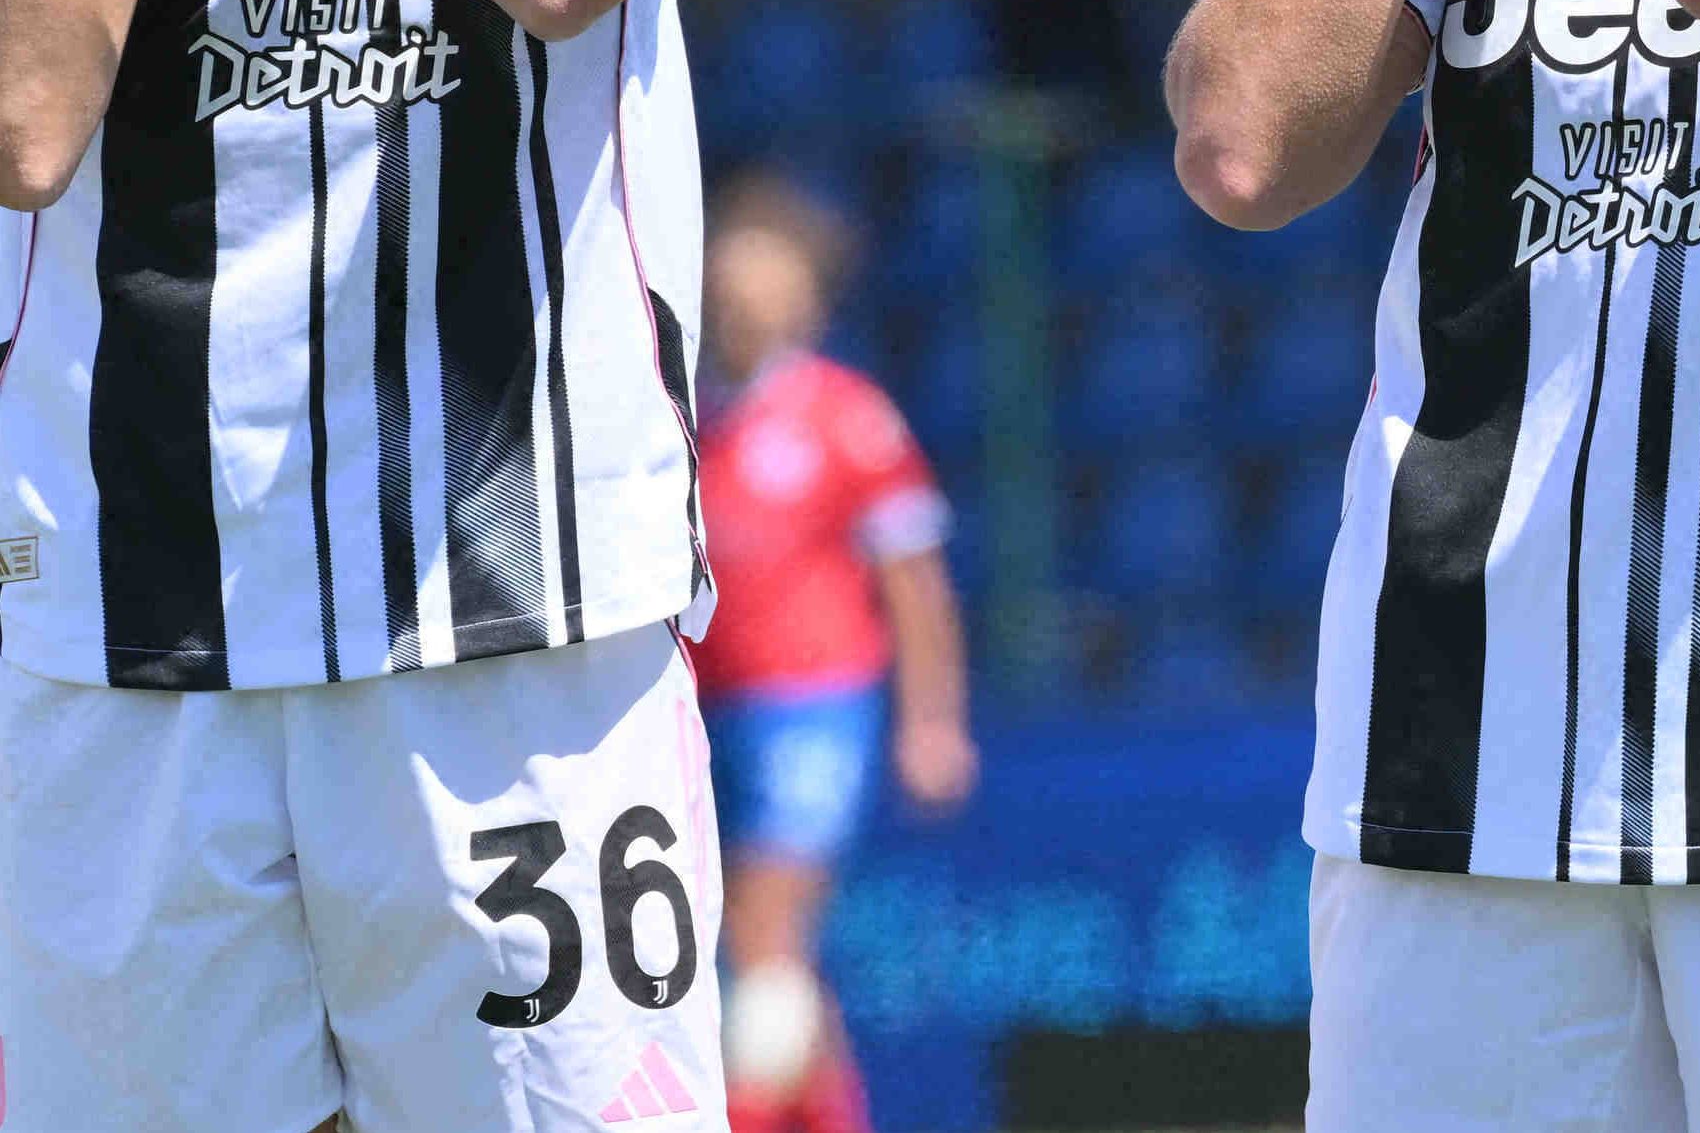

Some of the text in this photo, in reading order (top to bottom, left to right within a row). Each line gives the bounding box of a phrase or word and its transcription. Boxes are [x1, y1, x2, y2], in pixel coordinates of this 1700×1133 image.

[188, 30, 461, 123] Detroit
[1563, 120, 1689, 178] VISIT
[470, 805, 697, 1029] 36
